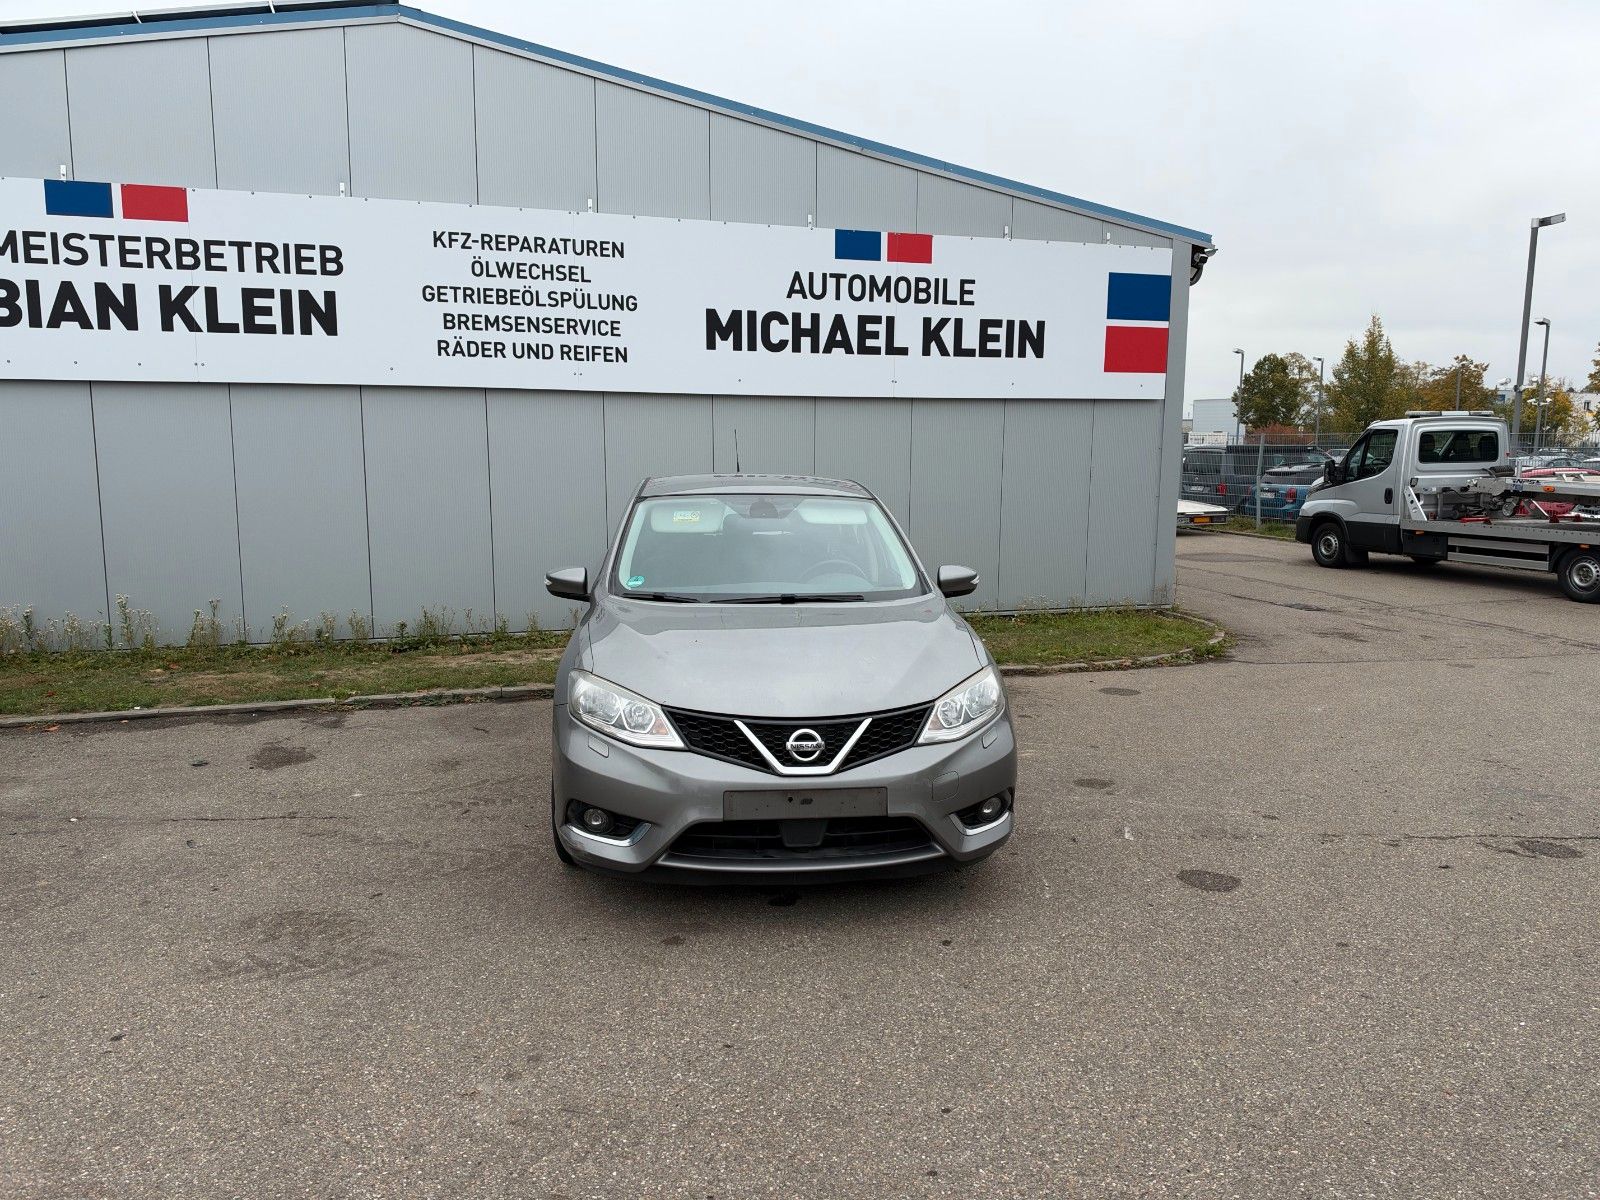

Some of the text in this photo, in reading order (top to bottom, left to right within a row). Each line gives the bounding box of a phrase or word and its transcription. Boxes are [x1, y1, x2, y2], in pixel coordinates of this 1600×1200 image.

[432, 231, 625, 258] KFZ-REPARATUREN
[471, 256, 592, 283] ÖLWECHSEL
[421, 284, 638, 311] GETRIEBEÖLSPÜLUNG
[786, 270, 976, 306] AUTOMOBILE
[158, 284, 338, 336] KLEIN
[442, 312, 622, 337] BREMSENSERVICE
[705, 308, 1046, 359] MICHAEL KLEIN
[437, 336, 628, 363] RÄDER UND REIFEN
